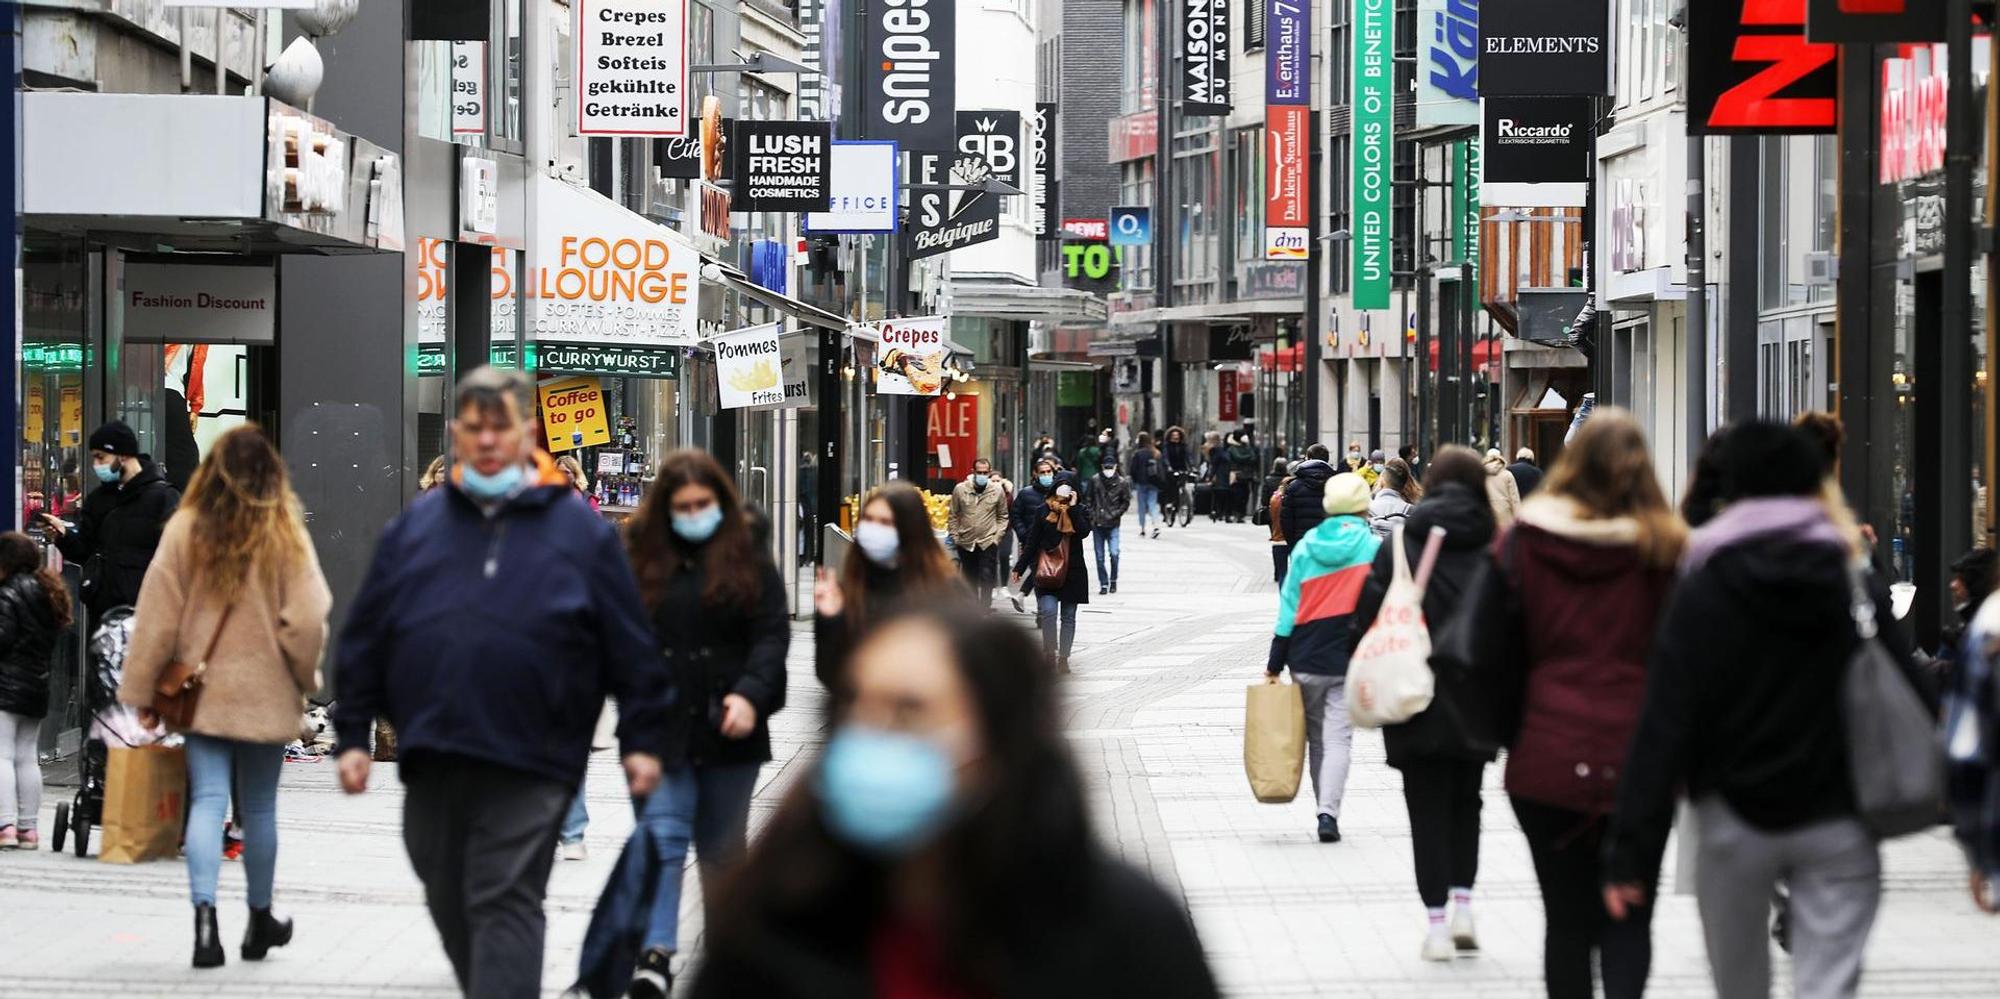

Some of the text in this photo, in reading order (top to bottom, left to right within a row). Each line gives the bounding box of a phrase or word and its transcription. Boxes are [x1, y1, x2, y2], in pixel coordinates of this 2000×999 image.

[599, 9, 666, 26] Crepes
[601, 32, 664, 46] Brezel
[1485, 37, 1600, 54] ELEMENTS
[1187, 0, 1208, 103] MAISON
[597, 56, 667, 70] Softeis
[882, 0, 940, 124] snipe
[588, 80, 676, 96] gekühlte
[1364, 86, 1381, 114] OF
[586, 103, 679, 117] Getränke
[1498, 119, 1570, 137] Riccardo
[749, 135, 821, 154] LUSH
[749, 157, 821, 173] FRESH
[1284, 111, 1296, 221] Das kleine Steakhaus
[1363, 121, 1381, 203] COLORS
[749, 176, 820, 186] HANDMADE
[749, 188, 820, 198] COSMETICS
[915, 217, 993, 250] Belgique
[1275, 232, 1302, 248] dm
[560, 236, 670, 270] FOOD
[1363, 211, 1381, 281] UNITED
[540, 268, 688, 304] LOUNGE
[131, 291, 265, 310] Fashion Discount
[882, 324, 938, 348] Crêpes
[717, 339, 778, 360] Pommes
[546, 390, 598, 409] Coffee
[752, 391, 783, 404] Frites
[1224, 373, 1233, 413] SALE
[550, 407, 596, 424] to go
